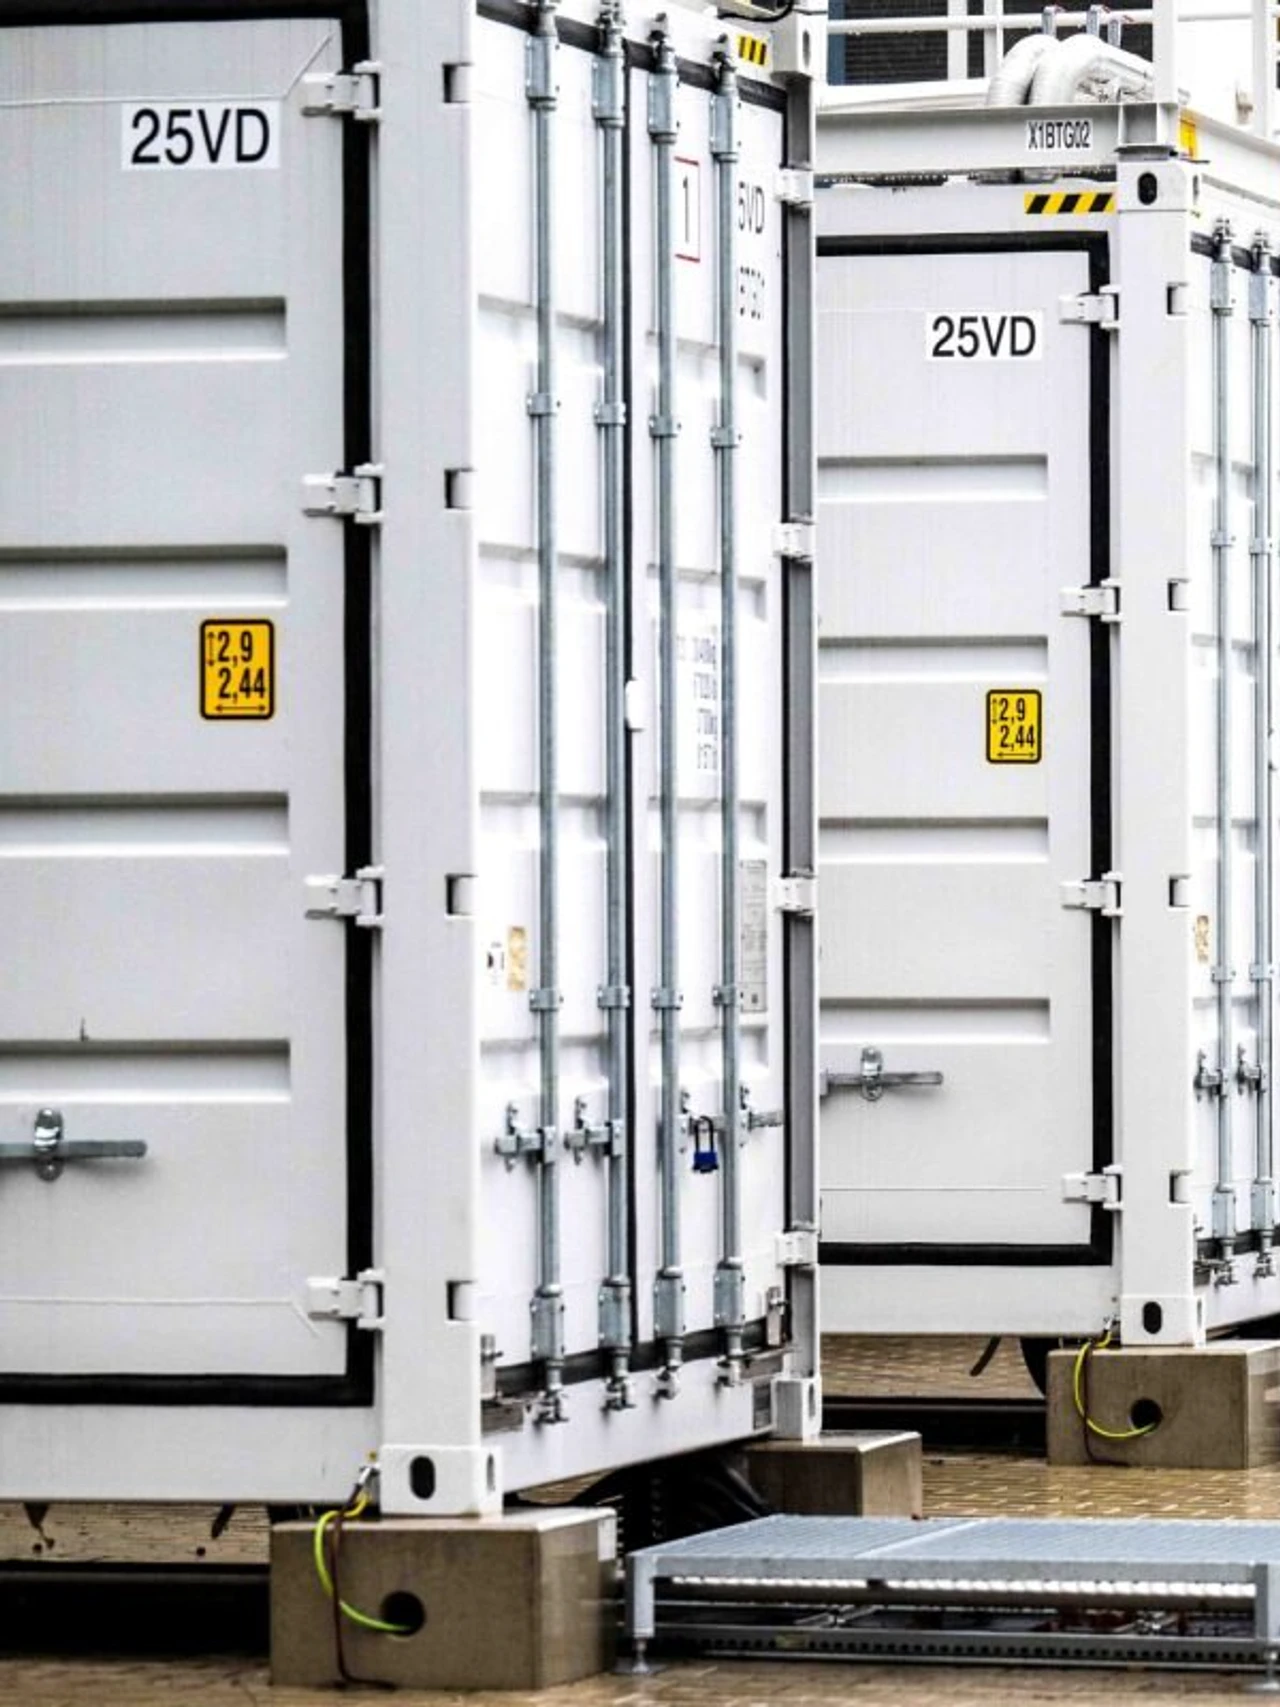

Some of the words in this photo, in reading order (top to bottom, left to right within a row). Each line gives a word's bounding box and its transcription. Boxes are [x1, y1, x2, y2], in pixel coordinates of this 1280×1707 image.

[132, 108, 270, 165] 25VD
[1028, 121, 1090, 149] X1BTG02
[738, 181, 765, 234] 5VD
[932, 315, 1036, 357] 25VD
[217, 630, 254, 668] 2,9
[217, 666, 266, 704] 2,44
[999, 697, 1026, 725] 2,9
[999, 723, 1035, 752] 2,44
